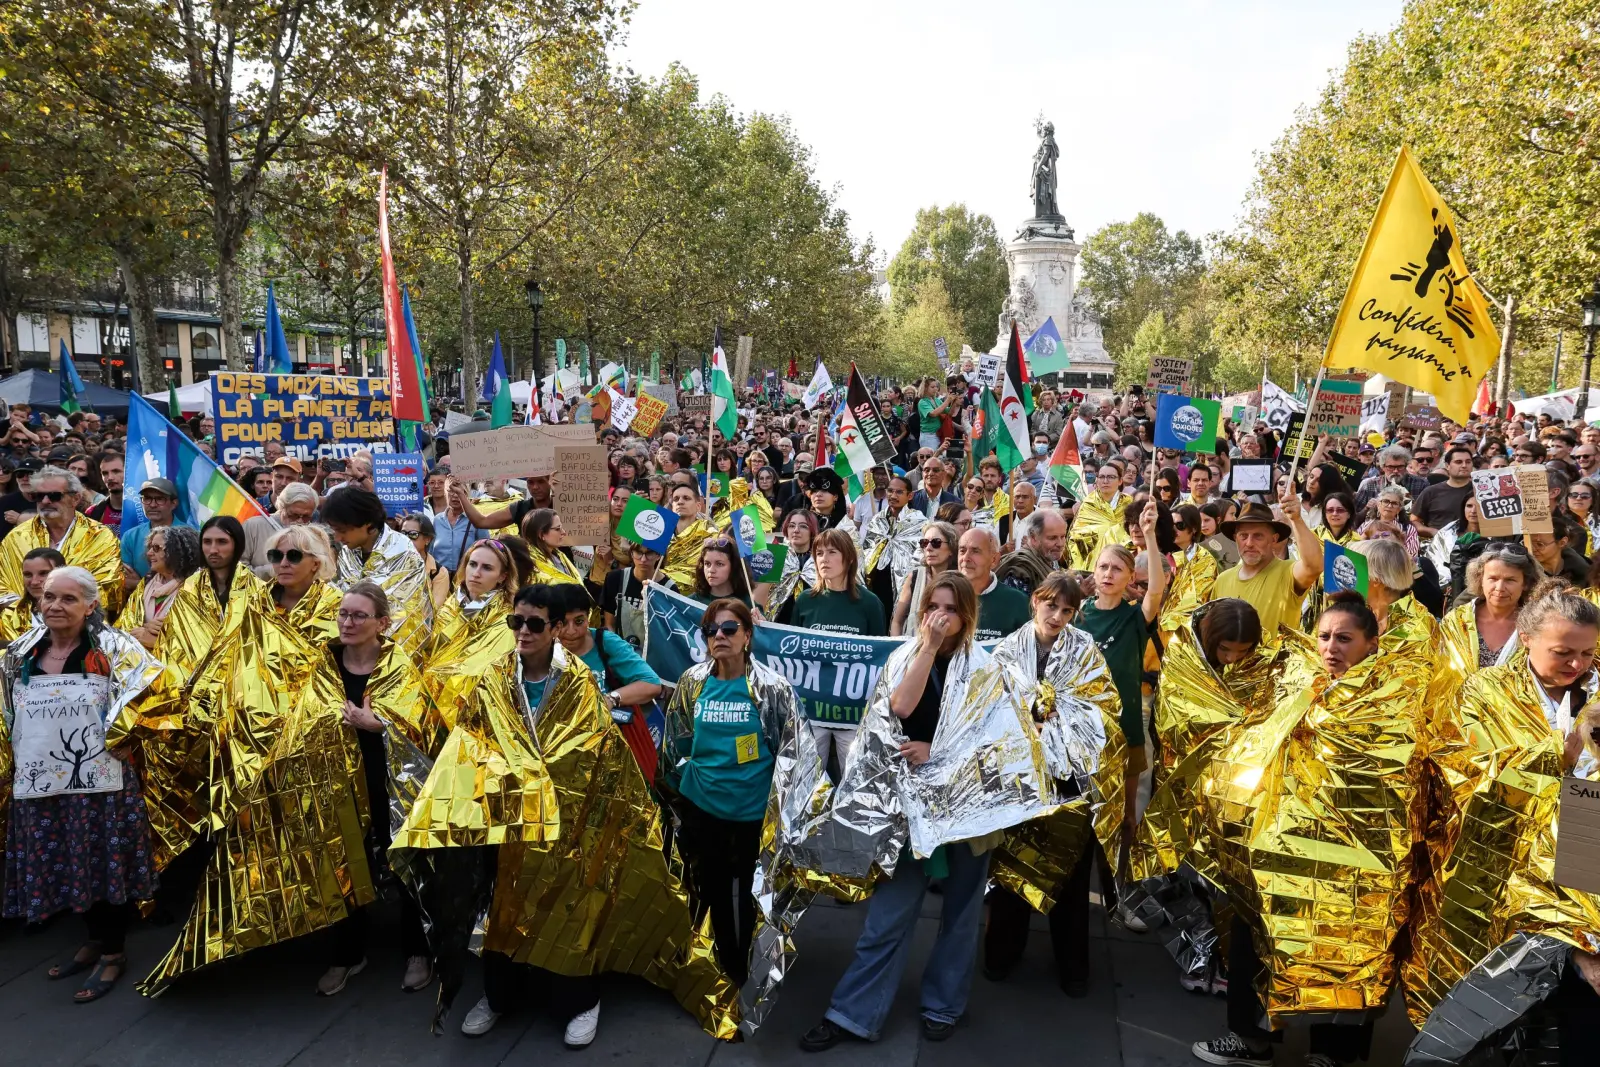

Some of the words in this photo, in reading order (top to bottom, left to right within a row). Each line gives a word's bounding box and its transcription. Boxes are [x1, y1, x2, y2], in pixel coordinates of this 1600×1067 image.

[1366, 332, 1456, 381] paysanne
[1154, 358, 1187, 368] SYSTEM
[1166, 374, 1189, 382] CLIMAT
[217, 374, 266, 394] DES
[278, 376, 359, 396] MOYENS
[369, 379, 392, 396] PO
[219, 399, 252, 418] LA
[369, 401, 392, 416] PA
[854, 402, 884, 446] SAHARA
[1310, 413, 1344, 424] MORT
[221, 423, 282, 442] POUR
[294, 422, 324, 440] LA
[332, 422, 394, 438] GUERR
[456, 438, 476, 450] NON
[484, 436, 499, 445] AUX
[506, 432, 539, 442] ACTIONS
[561, 452, 590, 461] DROITS
[456, 464, 475, 473] DROIT
[562, 460, 602, 472] BAFOUÉS
[562, 480, 604, 492] BRULÉES
[558, 492, 578, 503] QUI
[560, 506, 574, 514] PU
[577, 504, 608, 514] PRÉDIRE
[1486, 498, 1516, 510] STOP
[560, 516, 576, 524] UNE
[567, 525, 600, 536] ATALITÉ
[822, 624, 860, 633] générations
[975, 628, 1002, 636] érations
[802, 638, 874, 652] générations
[800, 650, 874, 660] FUTURES
[74, 694, 87, 702] le
[704, 700, 751, 712] LOCATAIRES
[702, 712, 750, 722] ENSEMBLE
[25, 760, 44, 768] SOS
